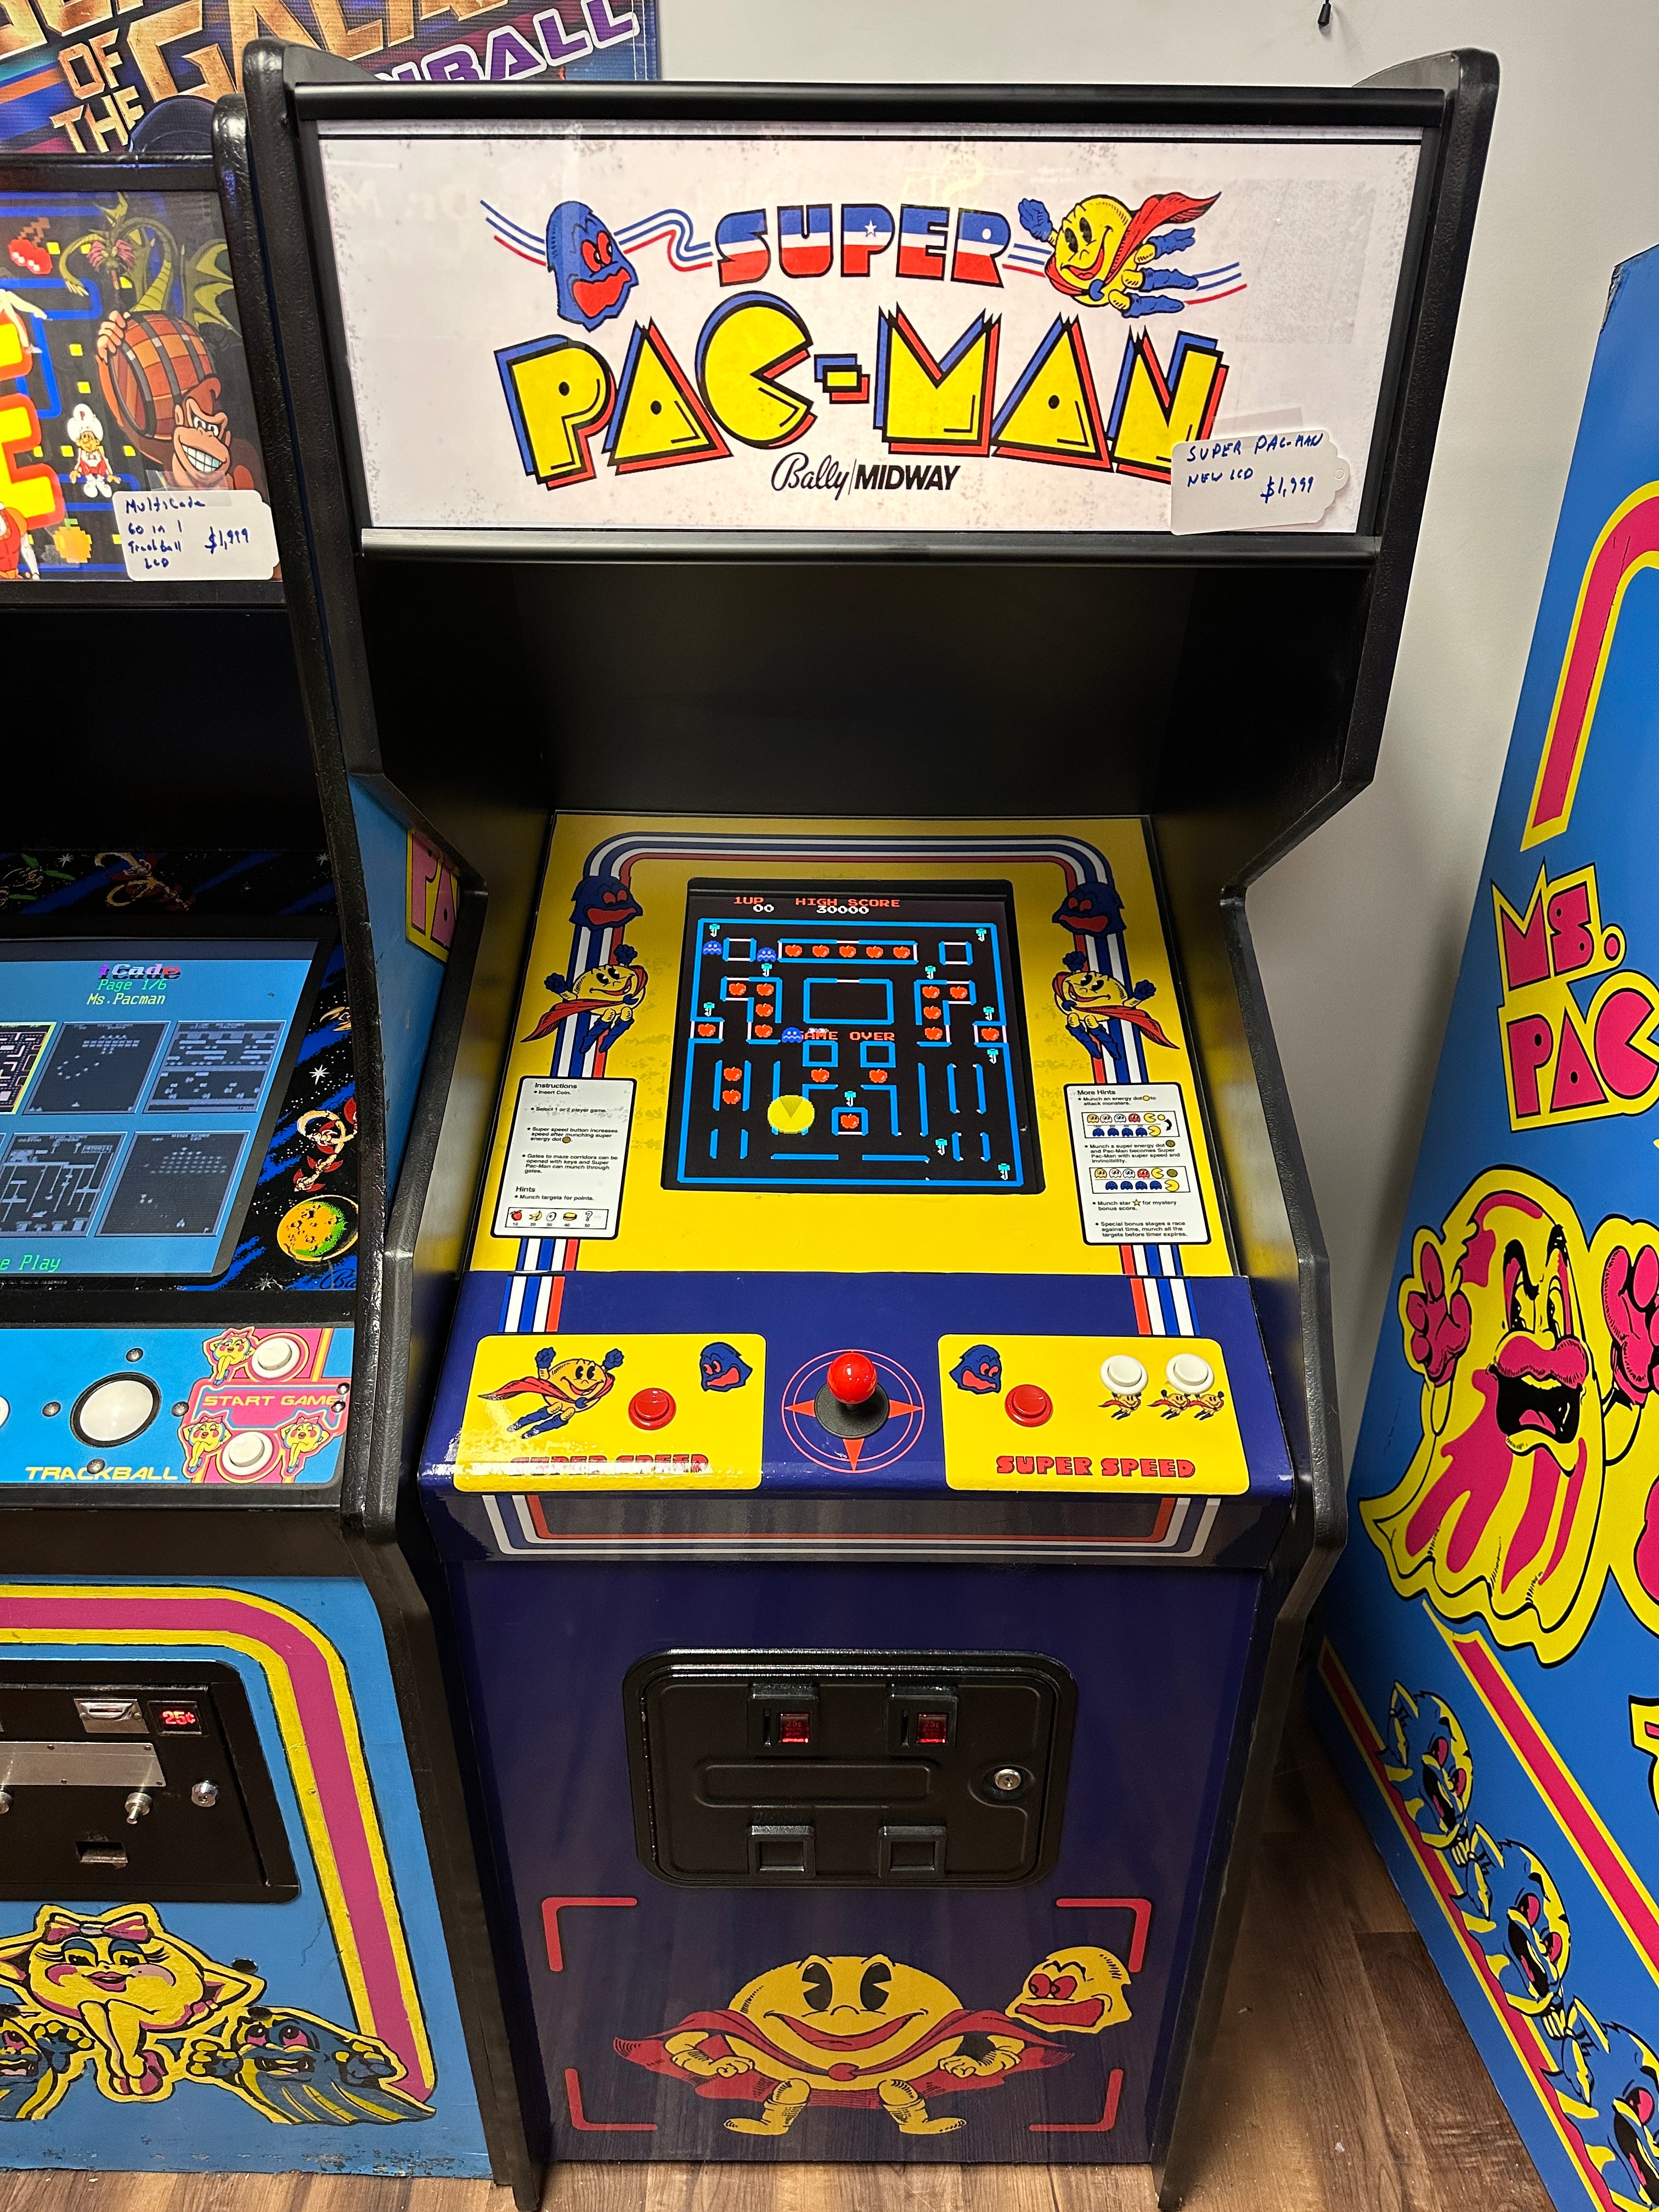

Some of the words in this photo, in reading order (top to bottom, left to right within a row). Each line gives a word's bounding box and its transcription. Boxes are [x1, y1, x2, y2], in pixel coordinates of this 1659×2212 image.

[58, 28, 123, 100] OF
[49, 86, 145, 154] THE
[715, 203, 1013, 288] SUPER
[494, 290, 1229, 490] PAC-MAN
[1187, 440, 1240, 462] SUPER
[1254, 433, 1323, 454] PAC-MAN
[771, 452, 850, 500] Bally
[854, 464, 961, 490] MIDWAY
[1187, 472, 1223, 487] NEW
[1230, 467, 1254, 480] LCD
[1260, 476, 1314, 504] $1,999
[128, 522, 144, 535] 60
[205, 526, 249, 554] $1,999
[753, 904, 775, 912] 00
[816, 905, 869, 914] 30000
[795, 898, 838, 906] HIGH
[848, 899, 900, 907] SCORE
[1491, 856, 1627, 991] MS.
[97, 963, 181, 980] iCade
[97, 979, 132, 992] Page
[142, 979, 167, 990] 1/6
[86, 992, 166, 1005] Ms.Pacman
[800, 1031, 838, 1040] AME
[850, 1031, 895, 1041] OVER
[19, 1255, 61, 1273] Play
[202, 1395, 276, 1406] START
[280, 1395, 339, 1406] GAME
[996, 1455, 1093, 1476] SUPER
[1101, 1458, 1195, 1478] SPEED
[162, 1711, 195, 1725] 25¢
